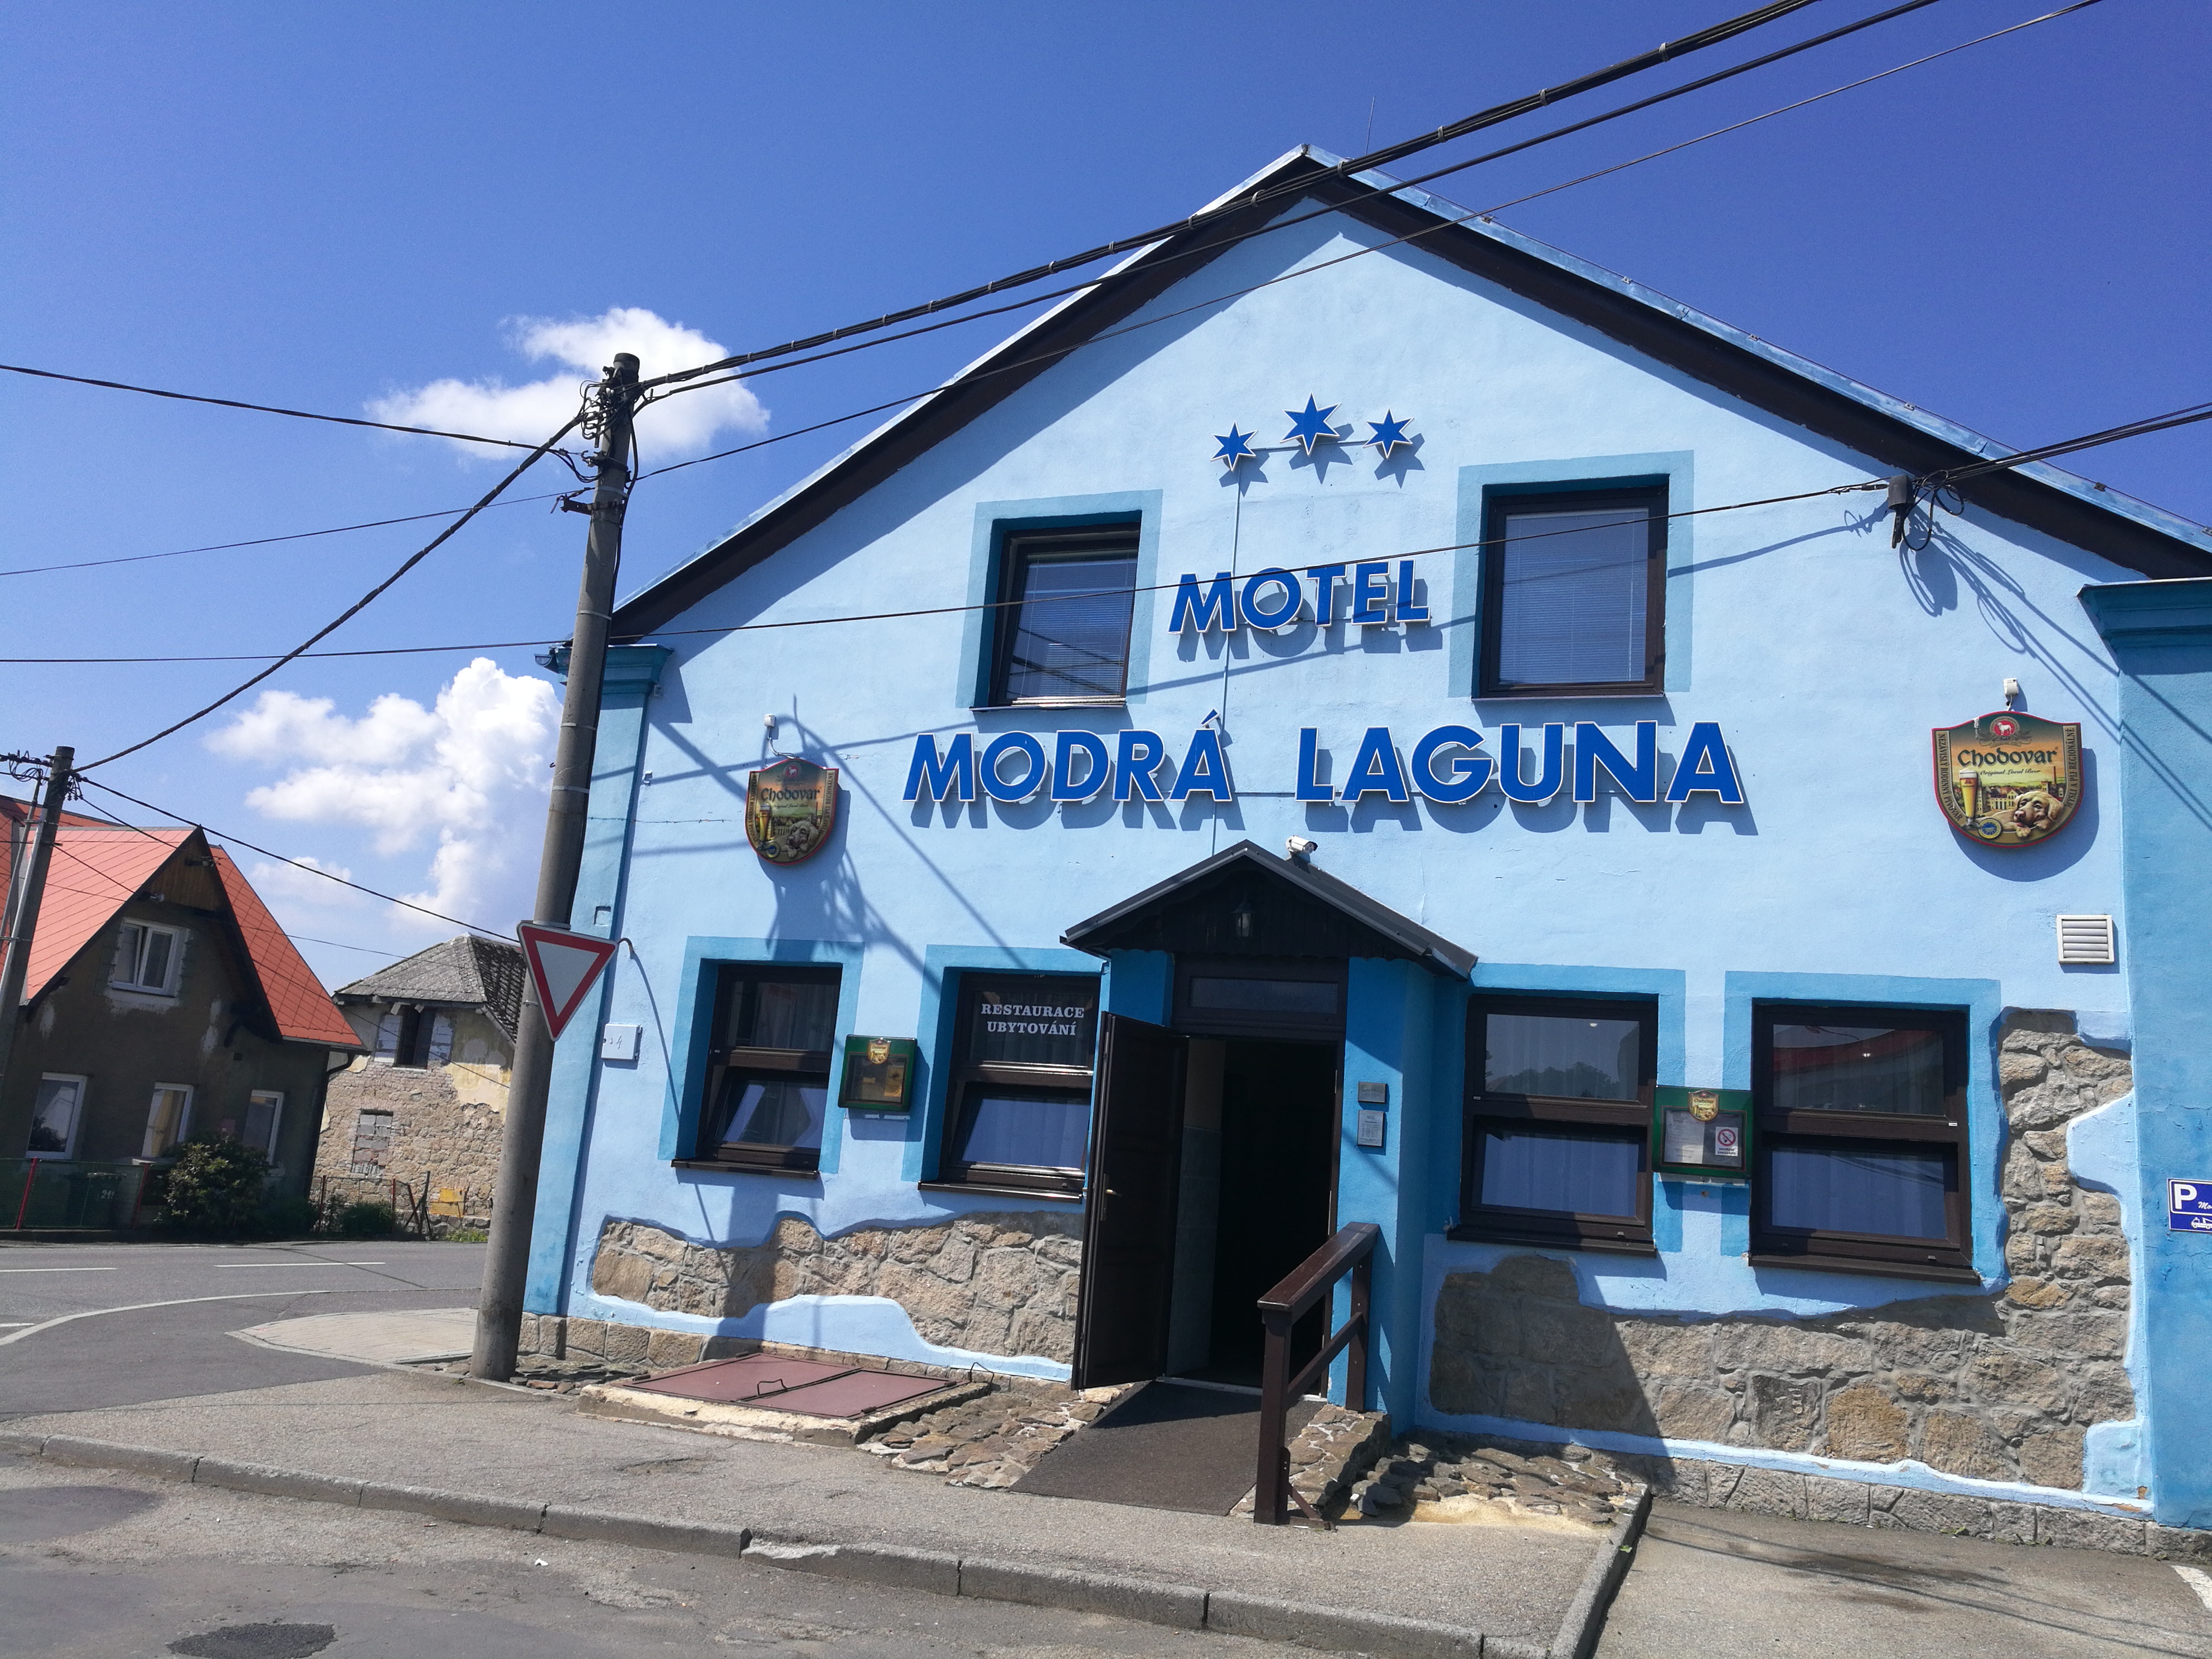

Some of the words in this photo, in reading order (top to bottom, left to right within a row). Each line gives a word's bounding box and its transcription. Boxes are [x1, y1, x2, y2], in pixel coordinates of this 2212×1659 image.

[1167, 559, 1431, 634] MOTEL
[902, 707, 1232, 802] MODRÁ
[1295, 720, 1744, 804] LAGUNA
[1938, 734, 1950, 766] NEZÁVISLÝ
[1957, 748, 2058, 768] Chodovar
[2065, 728, 2077, 770] REGIONÁLNĚ
[760, 786, 820, 802] Chodovar
[1940, 768, 1951, 795] RODINNÝ
[981, 1003, 1085, 1018] RESTAURACE
[987, 1020, 1076, 1036] UBYTOVÁNÍ
[2174, 1183, 2197, 1210] P
